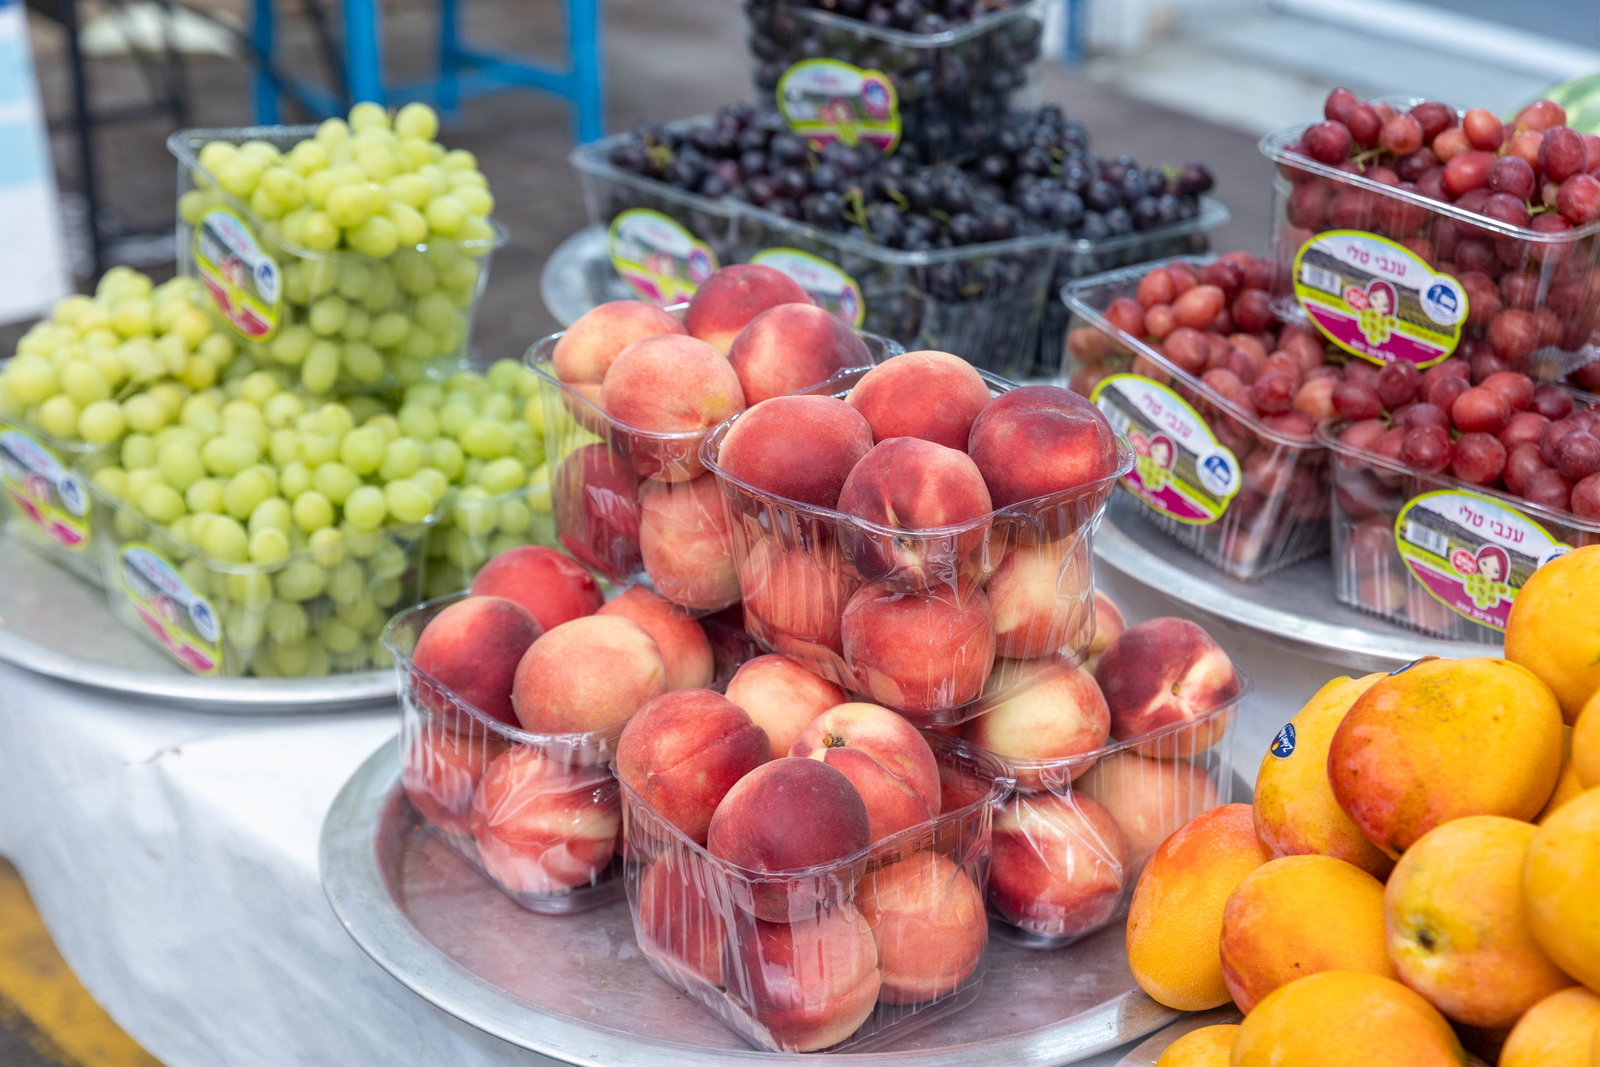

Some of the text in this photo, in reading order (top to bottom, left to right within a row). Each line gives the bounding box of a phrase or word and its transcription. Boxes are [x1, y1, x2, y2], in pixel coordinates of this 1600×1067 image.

[1346, 245, 1407, 277] ענבי טלי
[1459, 505, 1524, 543] ענבי טלי
